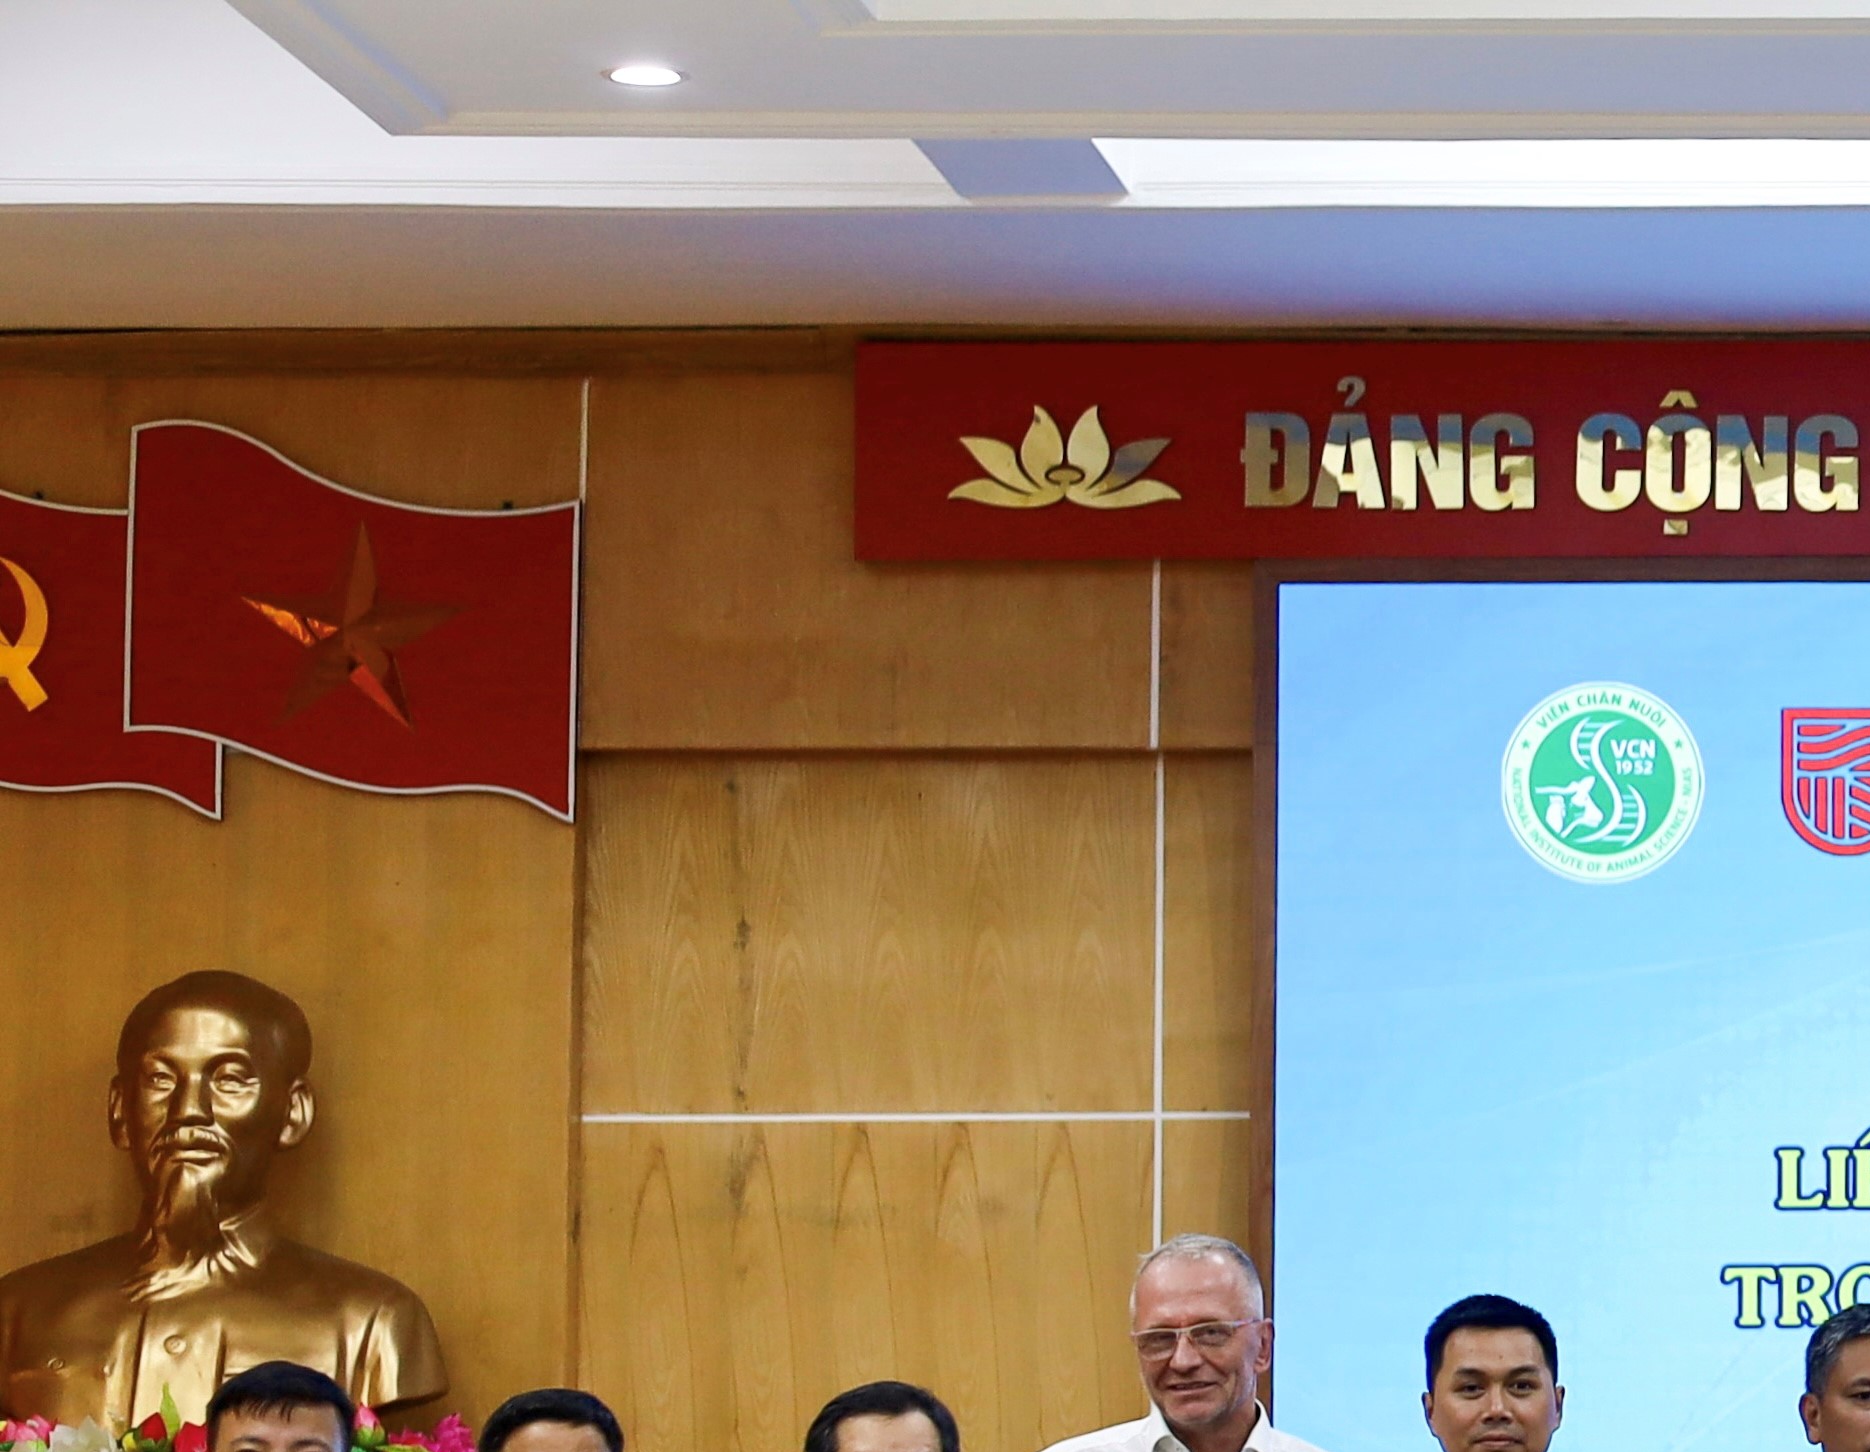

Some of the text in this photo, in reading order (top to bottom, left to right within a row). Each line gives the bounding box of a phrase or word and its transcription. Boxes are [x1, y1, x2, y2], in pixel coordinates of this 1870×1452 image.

[1240, 376, 1535, 511] ĐẢNG
[1575, 389, 1860, 535] CỘNG
[1610, 739, 1656, 759] VCN
[1615, 760, 1654, 776] 1952
